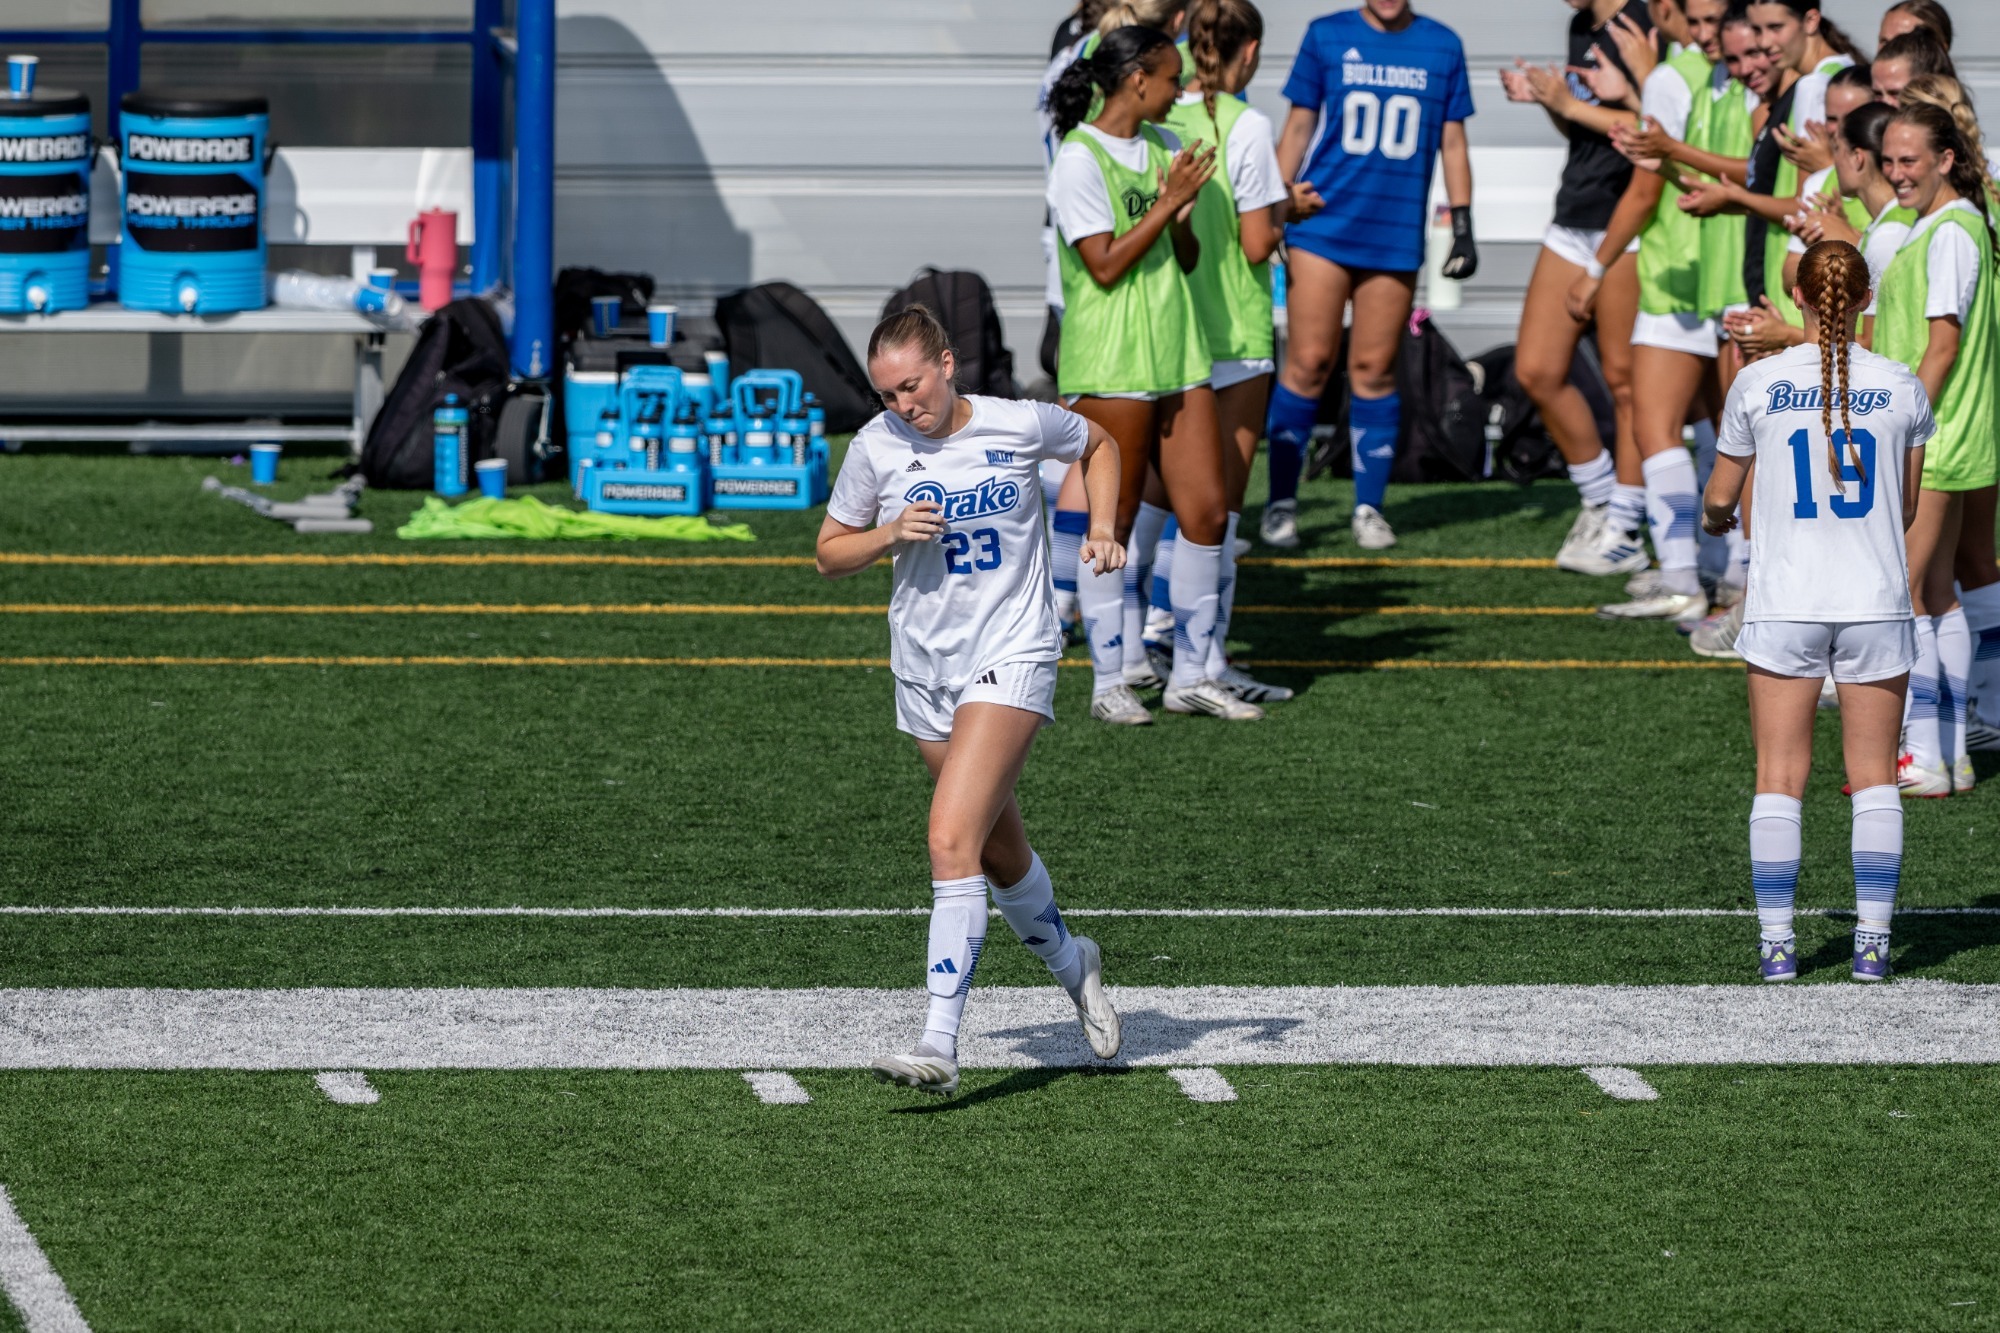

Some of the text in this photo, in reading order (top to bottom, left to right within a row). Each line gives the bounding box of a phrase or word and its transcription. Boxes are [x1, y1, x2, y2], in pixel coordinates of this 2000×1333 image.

[1342, 62, 1428, 91] BULLDOGS
[1341, 90, 1422, 160] 00
[0, 136, 87, 161] WERADE
[129, 135, 250, 162] POWERADE
[126, 193, 256, 217] POWERADE
[1766, 380, 1892, 416] Bulldogs
[905, 465, 926, 473] adidas
[985, 449, 1016, 465] VALLEY
[1787, 428, 1877, 519] 19
[602, 483, 686, 502] POWERADE
[714, 479, 796, 496] POWERADE
[904, 475, 1019, 525] Drake
[941, 527, 1002, 574] 23
